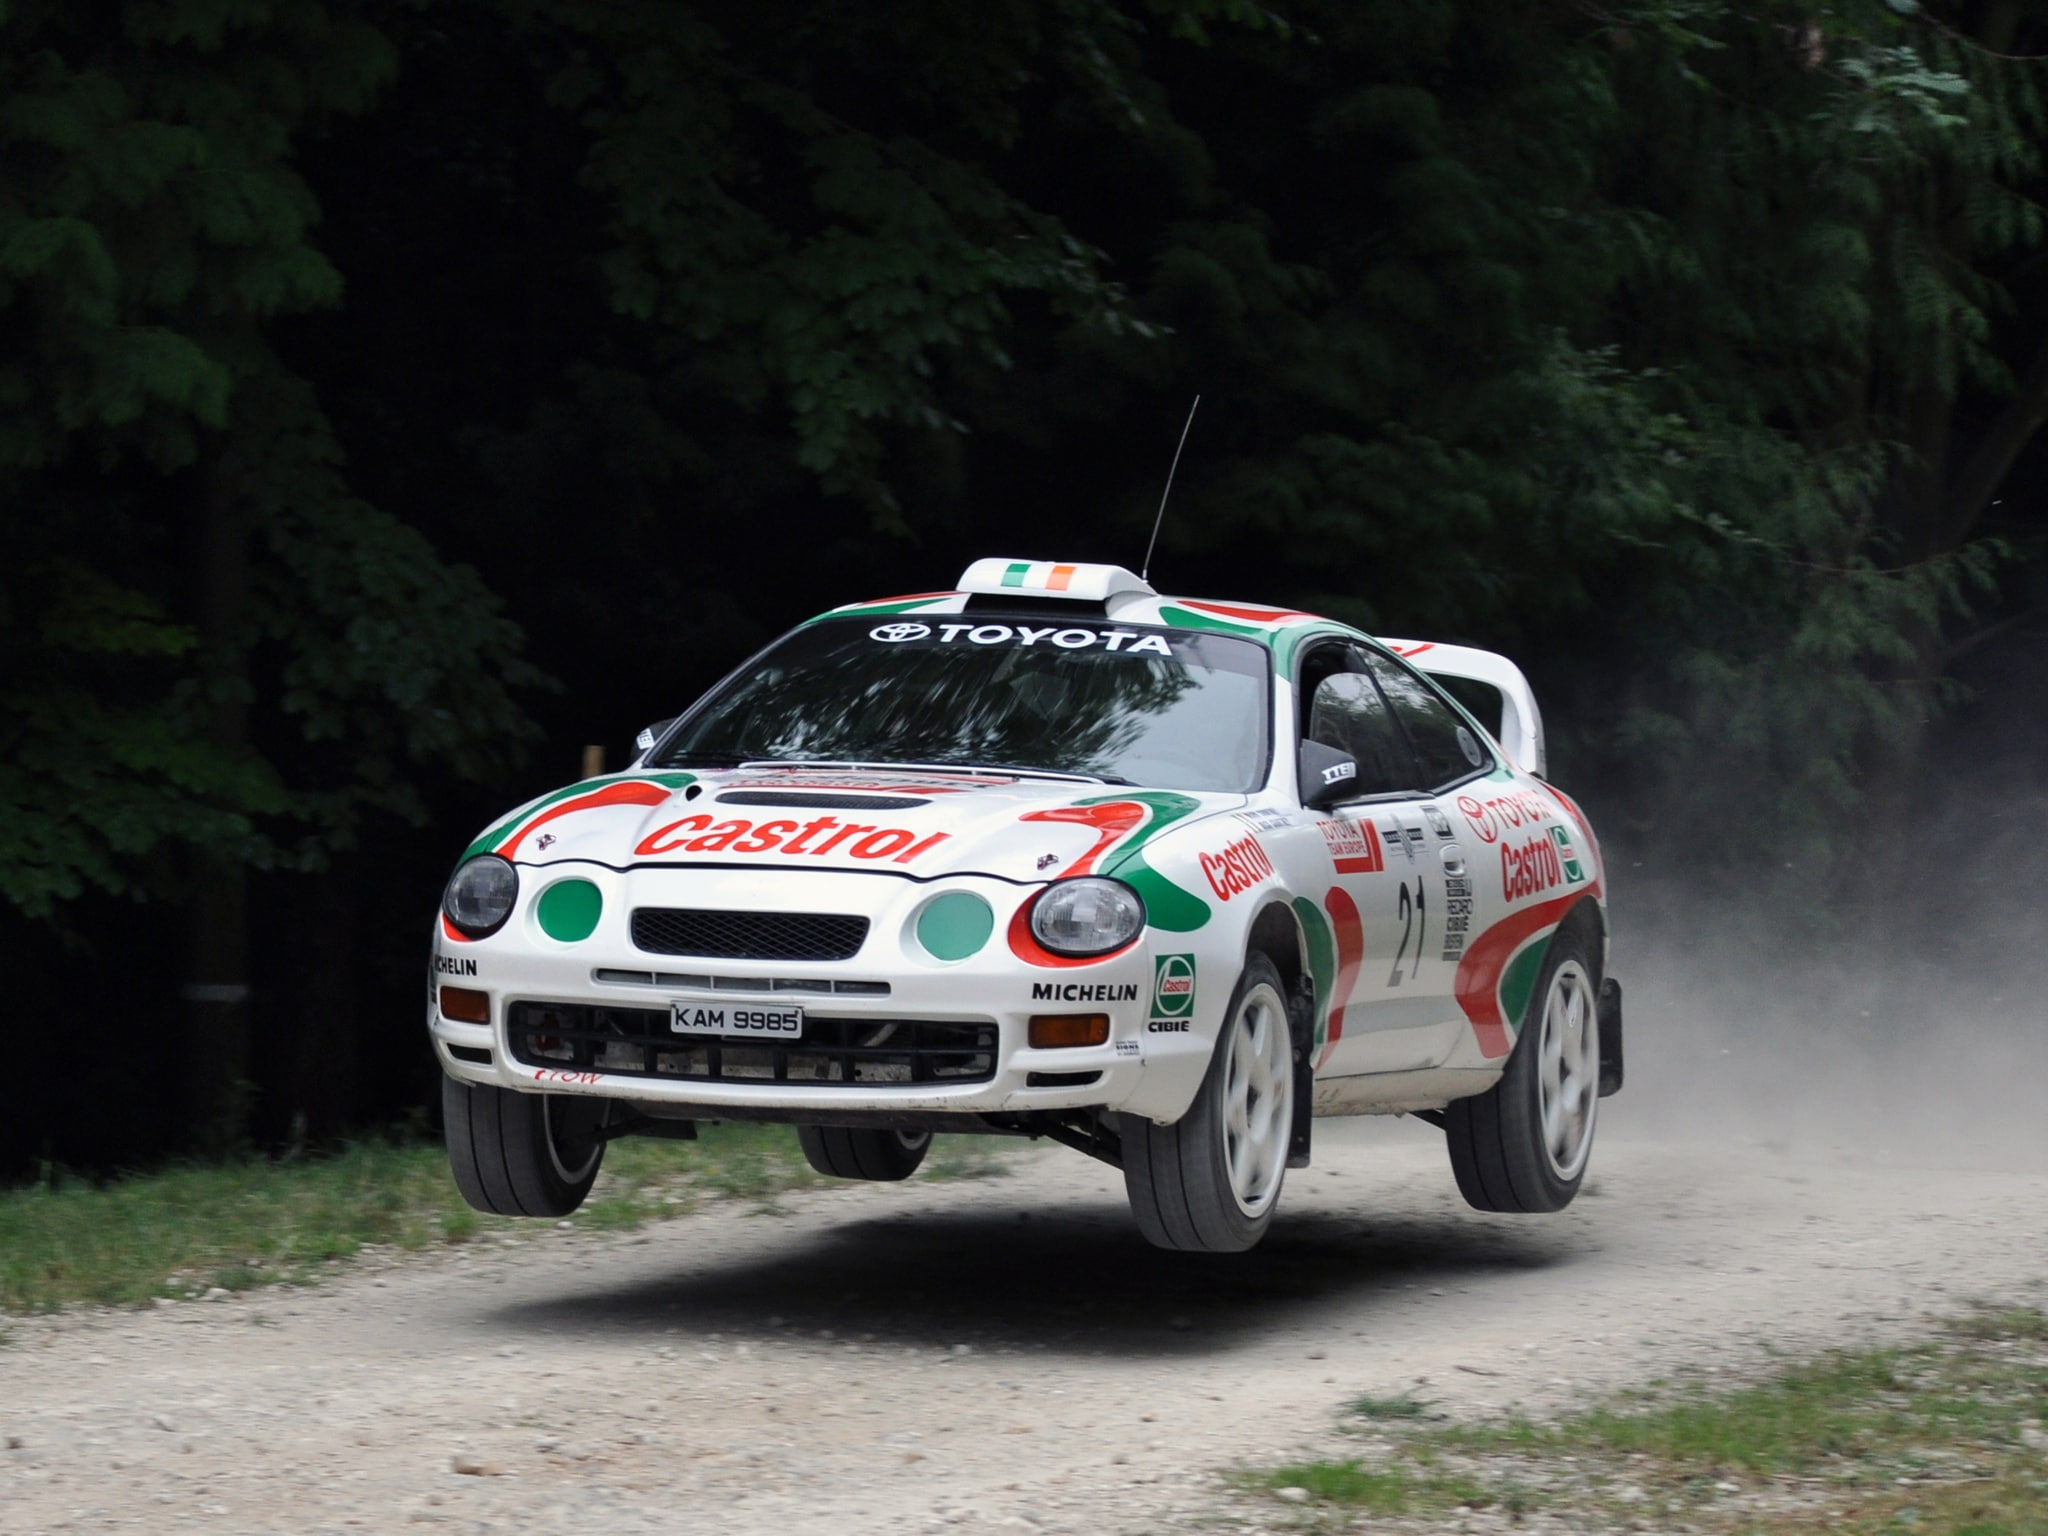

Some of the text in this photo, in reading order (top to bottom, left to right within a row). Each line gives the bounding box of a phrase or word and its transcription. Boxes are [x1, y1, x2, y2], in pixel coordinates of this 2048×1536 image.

[938, 624, 1173, 656] TOYOTA
[633, 814, 953, 864] Castrol
[1316, 819, 1361, 840] TOYOTA
[1327, 840, 1367, 855] TEAM EUROPE
[1199, 829, 1276, 902] Castrol
[1501, 828, 1562, 902] Castrol
[1386, 875, 1425, 988] 21
[1032, 983, 1138, 1001] MICHELIN
[1163, 978, 1191, 993] Castrol
[675, 1008, 798, 1031] KAM 9985
[1148, 1020, 1190, 1032] CIBIE
